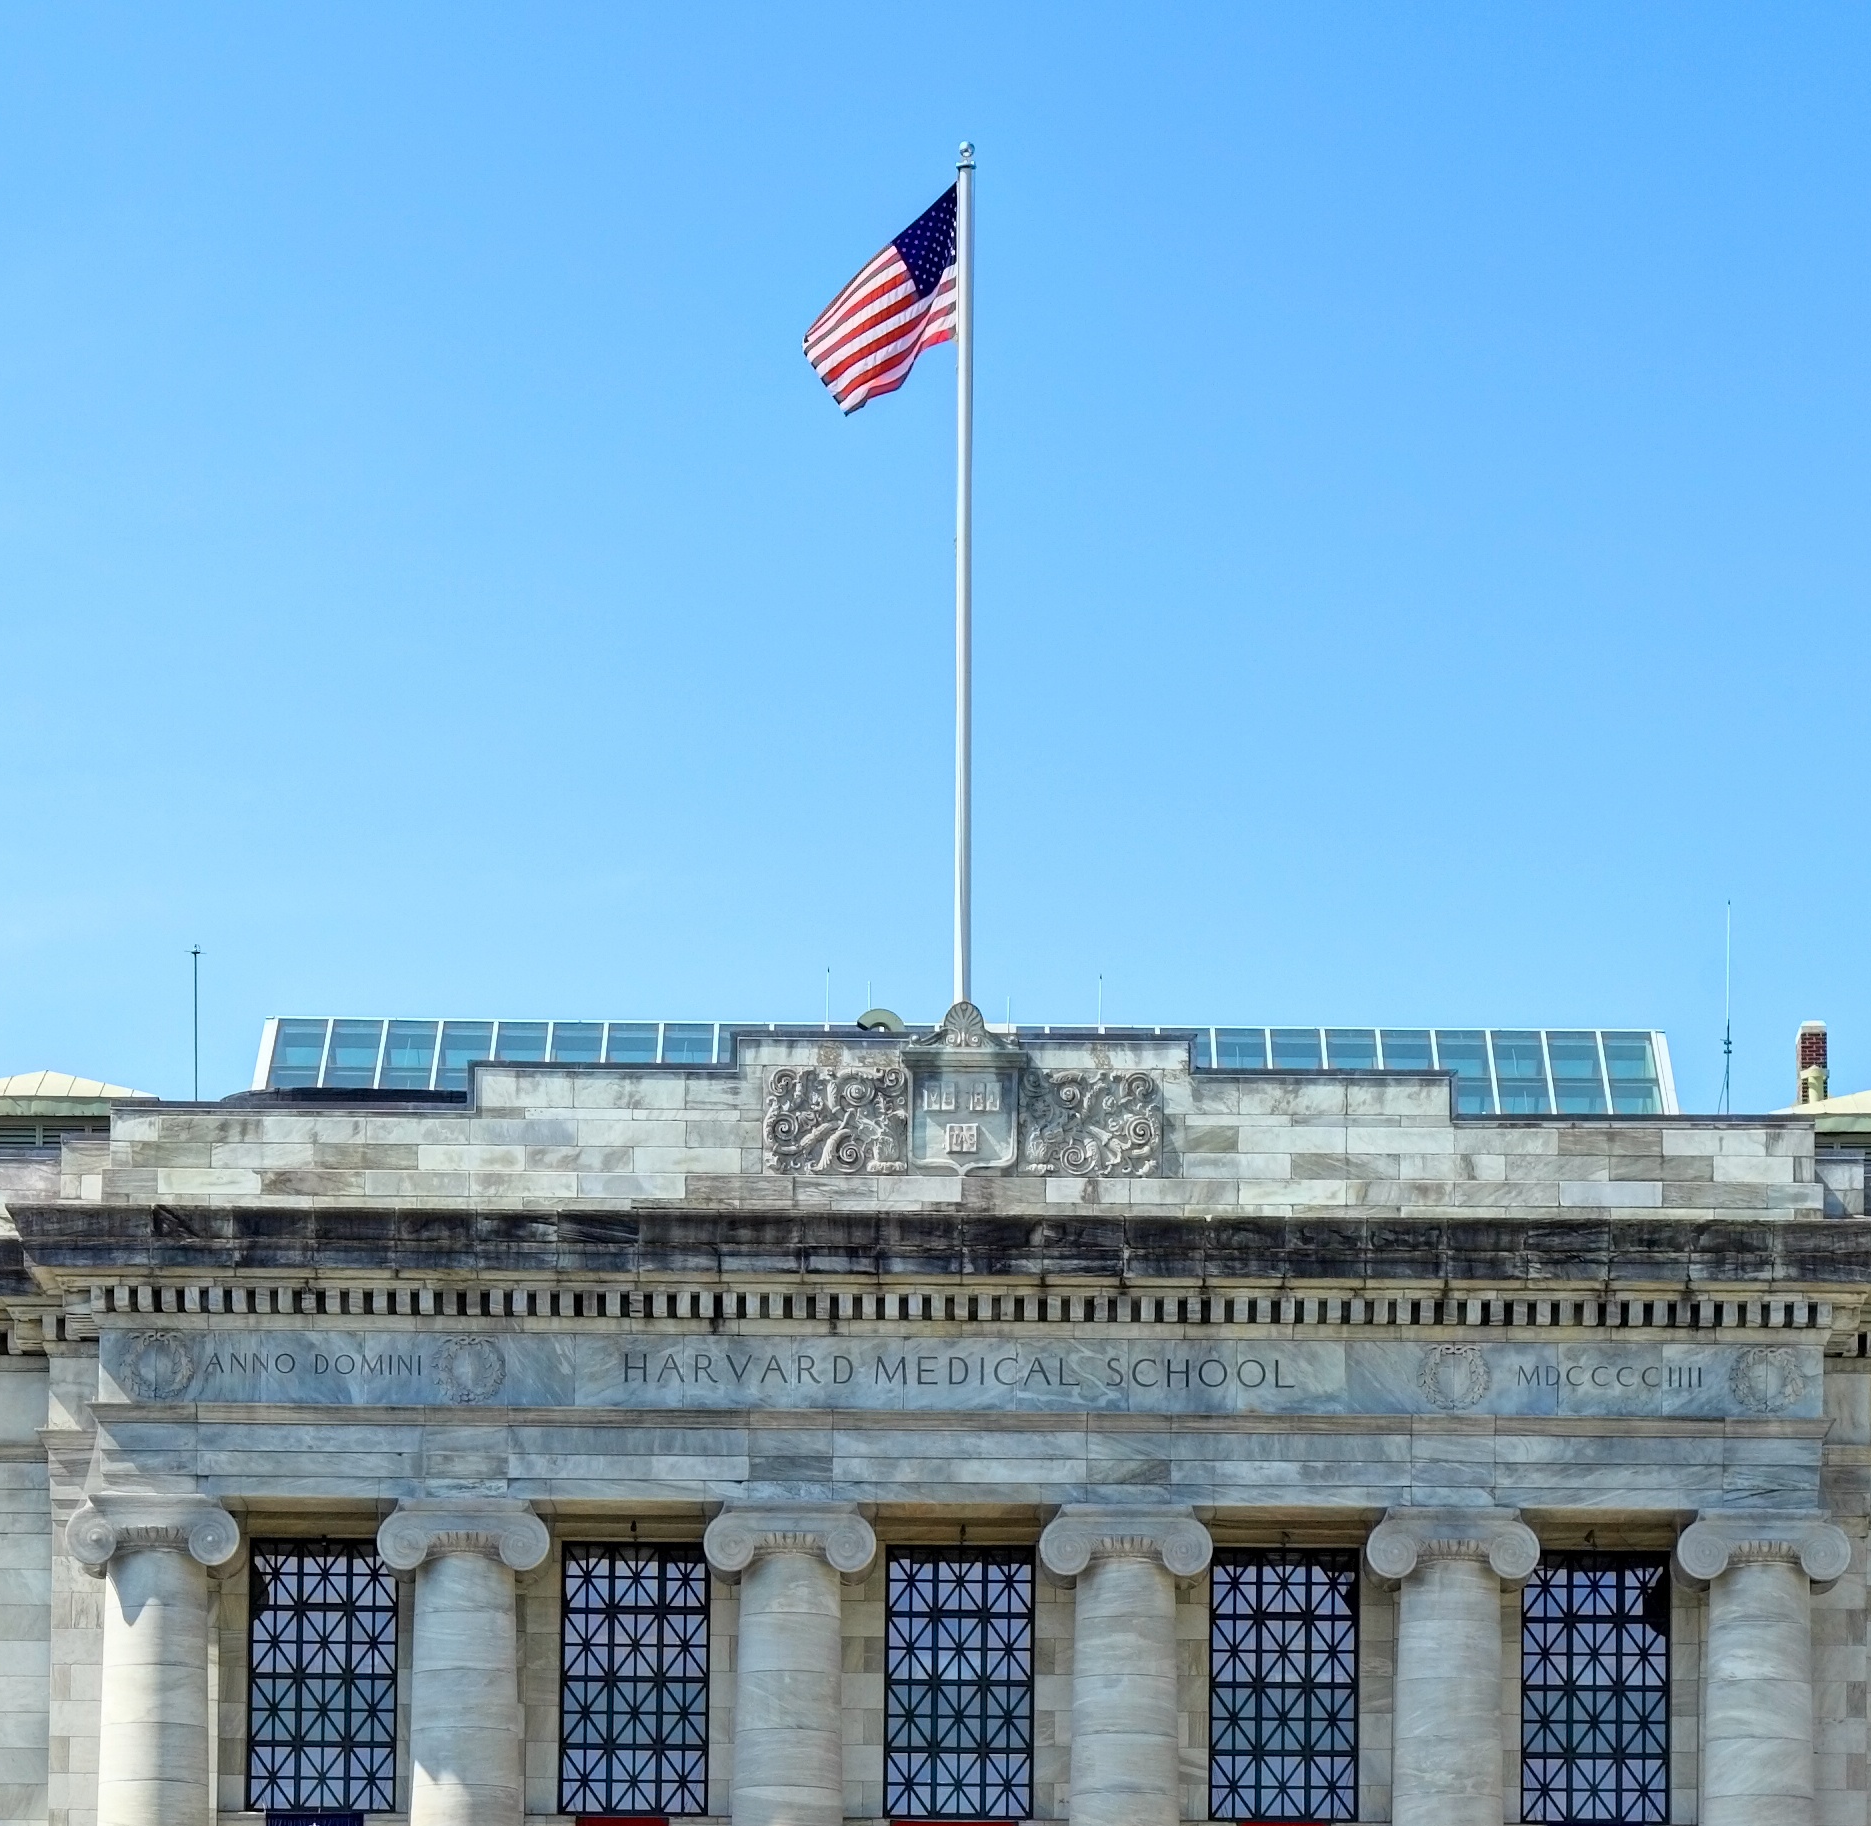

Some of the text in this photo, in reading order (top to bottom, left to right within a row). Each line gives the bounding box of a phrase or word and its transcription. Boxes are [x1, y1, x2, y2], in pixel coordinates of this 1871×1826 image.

[205, 1353, 422, 1376] ANNO DOMINI
[624, 1353, 1297, 1389] HARVARD MEDICAL SCHOOL
[1517, 1365, 1702, 1388] MDCCCCIIII
